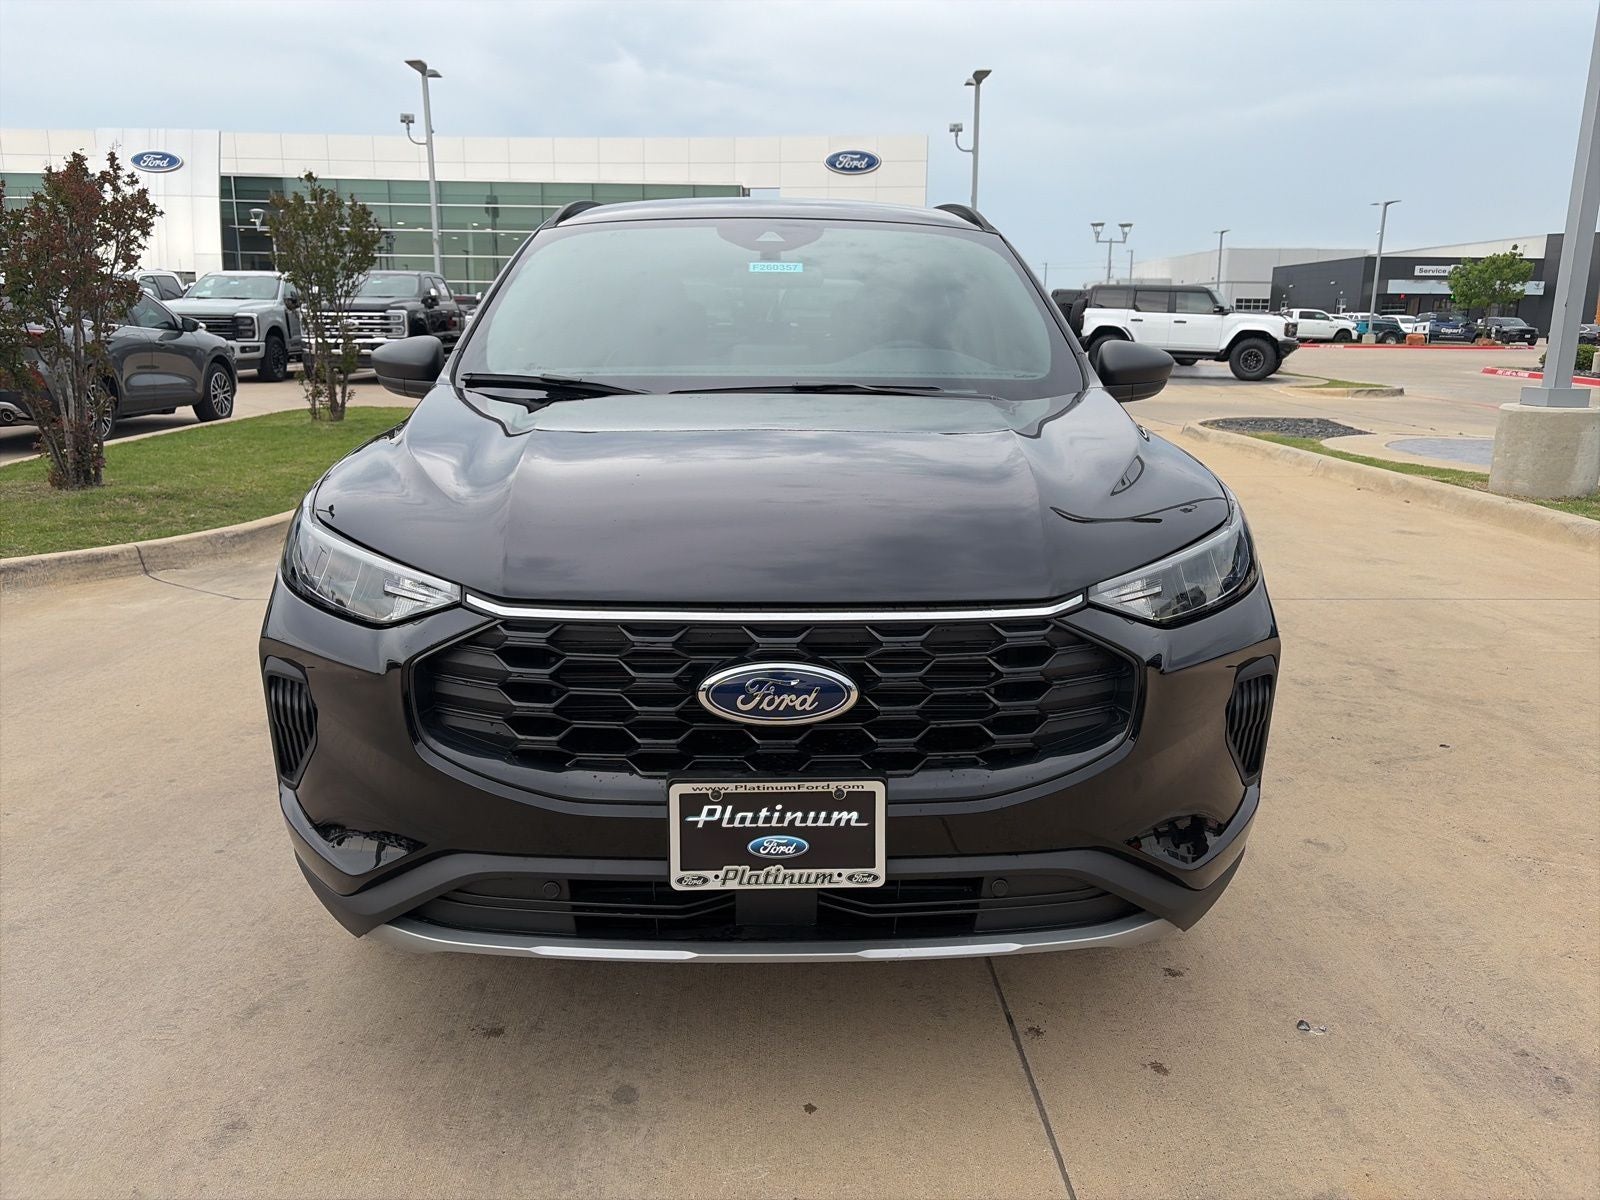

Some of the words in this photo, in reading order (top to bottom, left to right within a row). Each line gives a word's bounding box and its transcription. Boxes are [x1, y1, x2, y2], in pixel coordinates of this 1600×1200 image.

[140, 154, 169, 167] Ford
[836, 154, 868, 168] Ford
[736, 677, 820, 711] Ford
[692, 783, 865, 791] www.PlatinumFord.com
[684, 804, 869, 828] Platinum
[759, 838, 796, 854] Ford
[681, 875, 704, 887] Ford
[719, 865, 843, 887] Platinum
[852, 873, 876, 884] Ford
